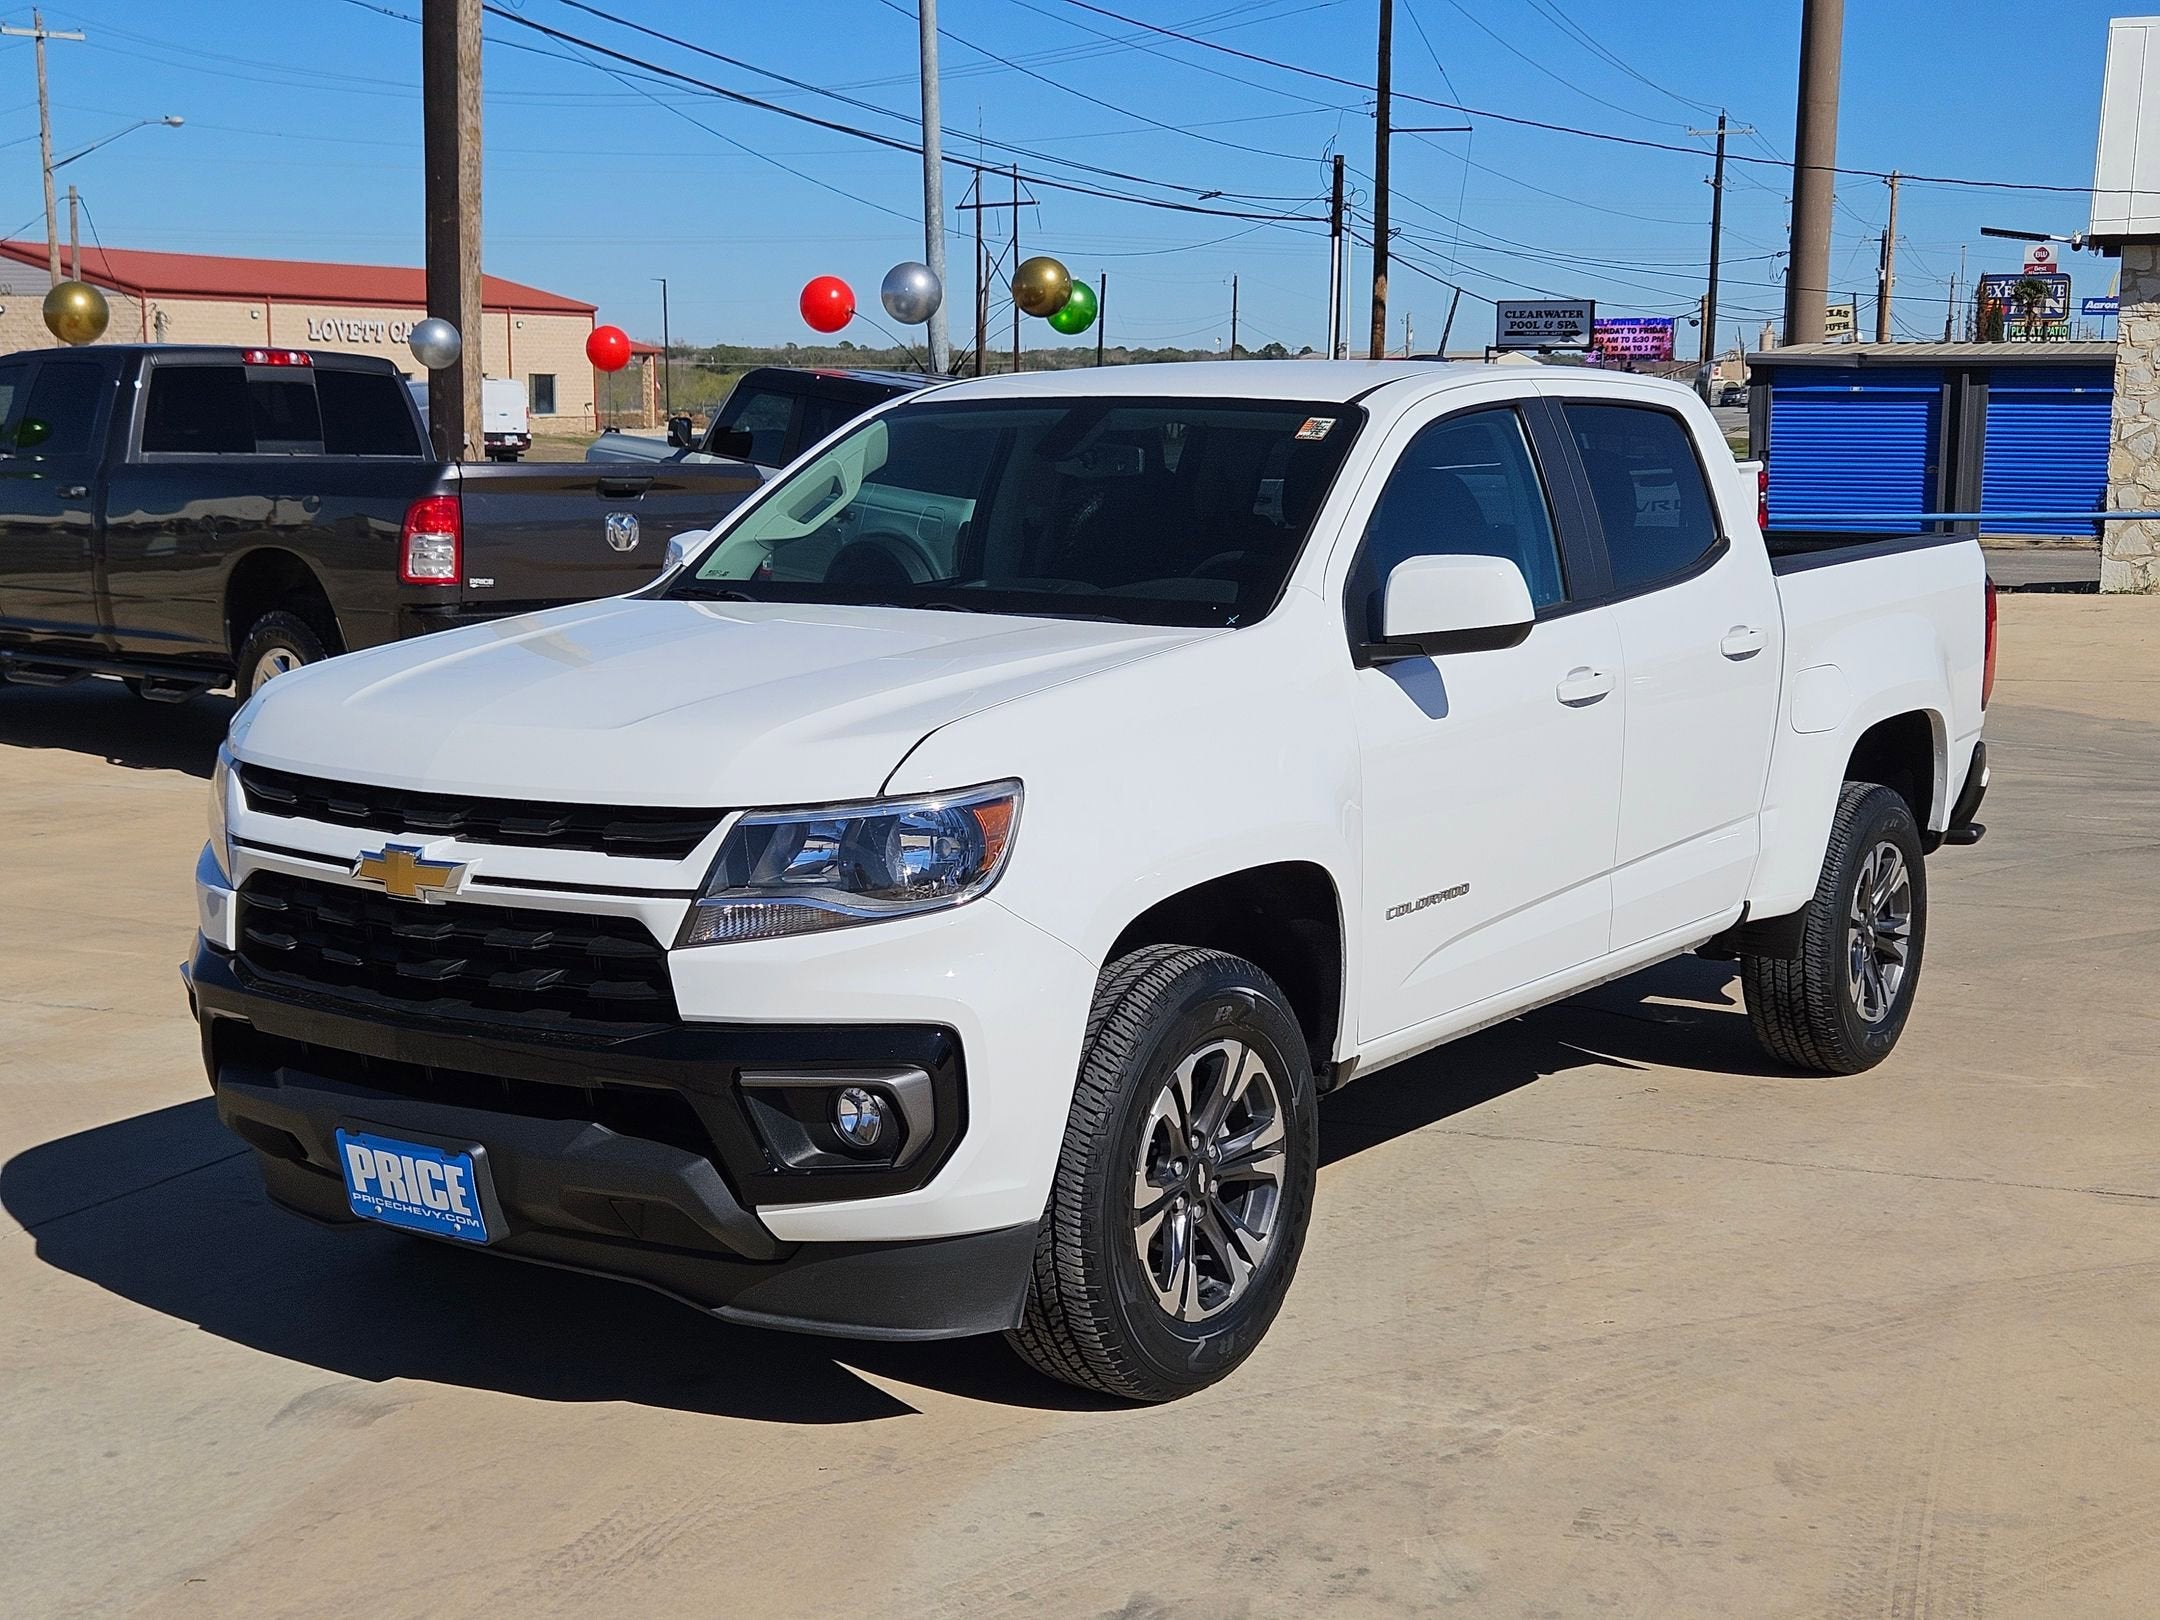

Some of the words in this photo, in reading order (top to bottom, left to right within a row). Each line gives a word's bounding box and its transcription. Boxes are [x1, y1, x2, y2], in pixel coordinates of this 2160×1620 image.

[1504, 310, 1584, 319] CLEARWATER
[308, 318, 384, 342] LOVETT
[1510, 321, 1540, 330] POOL
[1544, 321, 1553, 330] &
[1557, 321, 1578, 329] SPA
[2011, 326, 2036, 336] PLAA
[1605, 336, 1618, 344] AM
[1632, 335, 1650, 343] 5:30
[1651, 335, 1665, 343] PM
[1386, 883, 1469, 920] COLORADO
[346, 1144, 471, 1216] PRICE
[352, 1193, 480, 1227] PRICECHEVY.COM
